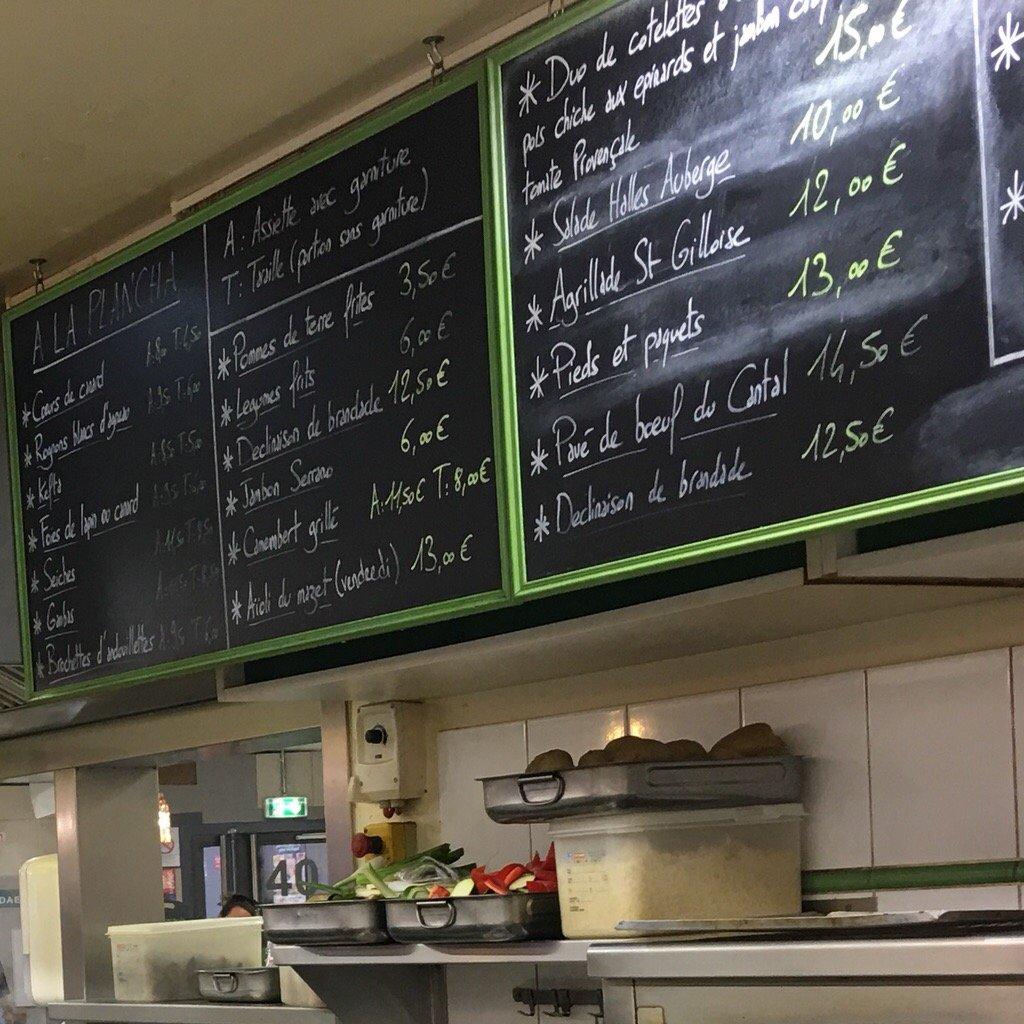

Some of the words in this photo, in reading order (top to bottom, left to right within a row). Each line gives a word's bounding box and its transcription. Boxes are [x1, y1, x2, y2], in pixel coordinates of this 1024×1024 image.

[522, 125, 545, 167] pois
[555, 87, 595, 138] chiche
[605, 80, 627, 113] aux
[703, 21, 725, 64] et
[731, 0, 780, 71] jambon
[545, 55, 586, 102] Duo
[597, 32, 617, 72] de
[573, 119, 641, 180] Provençale
[252, 195, 301, 246] Assiette
[310, 187, 337, 215] avec
[344, 147, 411, 215] garniture
[553, 196, 599, 247] Salade
[660, 146, 731, 200] Auberge
[340, 222, 363, 248] sans
[550, 255, 622, 327] Agrillade
[671, 209, 751, 271] Gilloise
[33, 321, 45, 365] A
[54, 304, 77, 354] LA
[88, 250, 178, 336] PLANCHA
[233, 331, 276, 371] Pommes
[283, 314, 300, 348] de
[305, 306, 335, 337] terre
[343, 281, 376, 339] frites
[550, 340, 600, 390] Pieds
[613, 324, 637, 367] et
[645, 297, 706, 369] paquets
[65, 378, 76, 406] de
[308, 405, 322, 440] de
[328, 383, 384, 432] brandade
[552, 416, 595, 466] Pavé
[600, 411, 623, 452] de
[694, 380, 716, 422] du
[728, 348, 789, 412] Cantal
[38, 472, 62, 510] Kefta
[290, 458, 333, 492] Serrano
[648, 468, 667, 503] de
[678, 447, 753, 498] brandade
[64, 509, 76, 539] de
[244, 509, 302, 558] Camembert
[304, 500, 339, 553] grillé
[278, 578, 292, 608] du
[267, 858, 319, 896] 40
